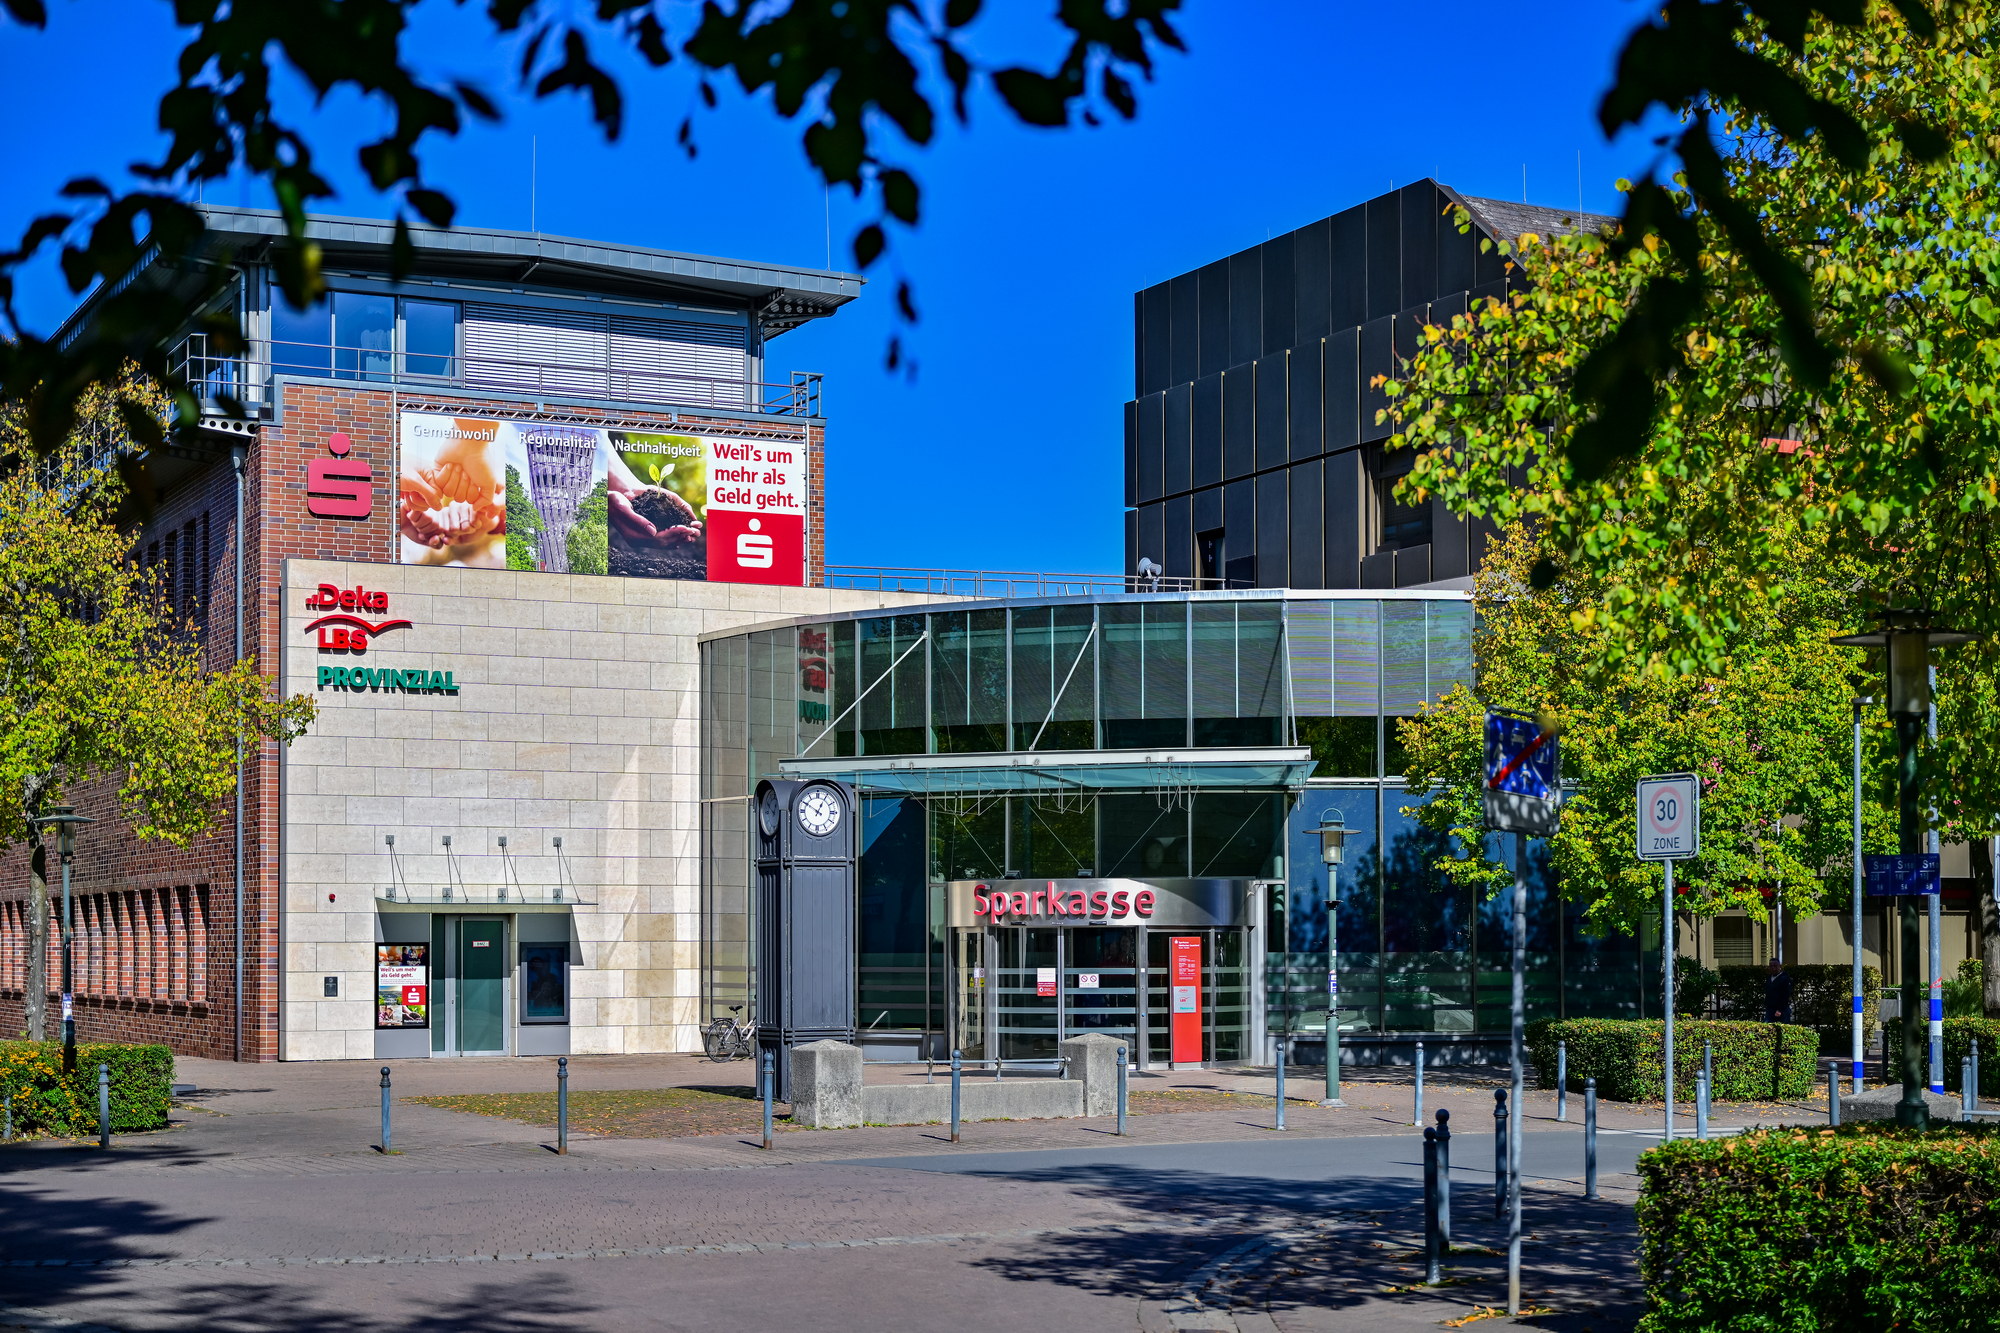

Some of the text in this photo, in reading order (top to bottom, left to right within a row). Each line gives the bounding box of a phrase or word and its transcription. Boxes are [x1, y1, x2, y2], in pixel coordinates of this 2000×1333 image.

[412, 424, 495, 442] Gemeinwohl
[518, 431, 597, 449] Regionalität
[614, 438, 701, 459] Nachhaltigkeit
[766, 450, 793, 464] um
[714, 466, 786, 485] mehr als
[713, 487, 799, 510] Geld geht.
[317, 583, 389, 609] Deka
[317, 627, 368, 651] LBS
[317, 665, 460, 691] PROVINZIAL
[1656, 798, 1677, 822] 30
[1653, 836, 1681, 850] ZONE
[973, 881, 1156, 925] Sparkasse
